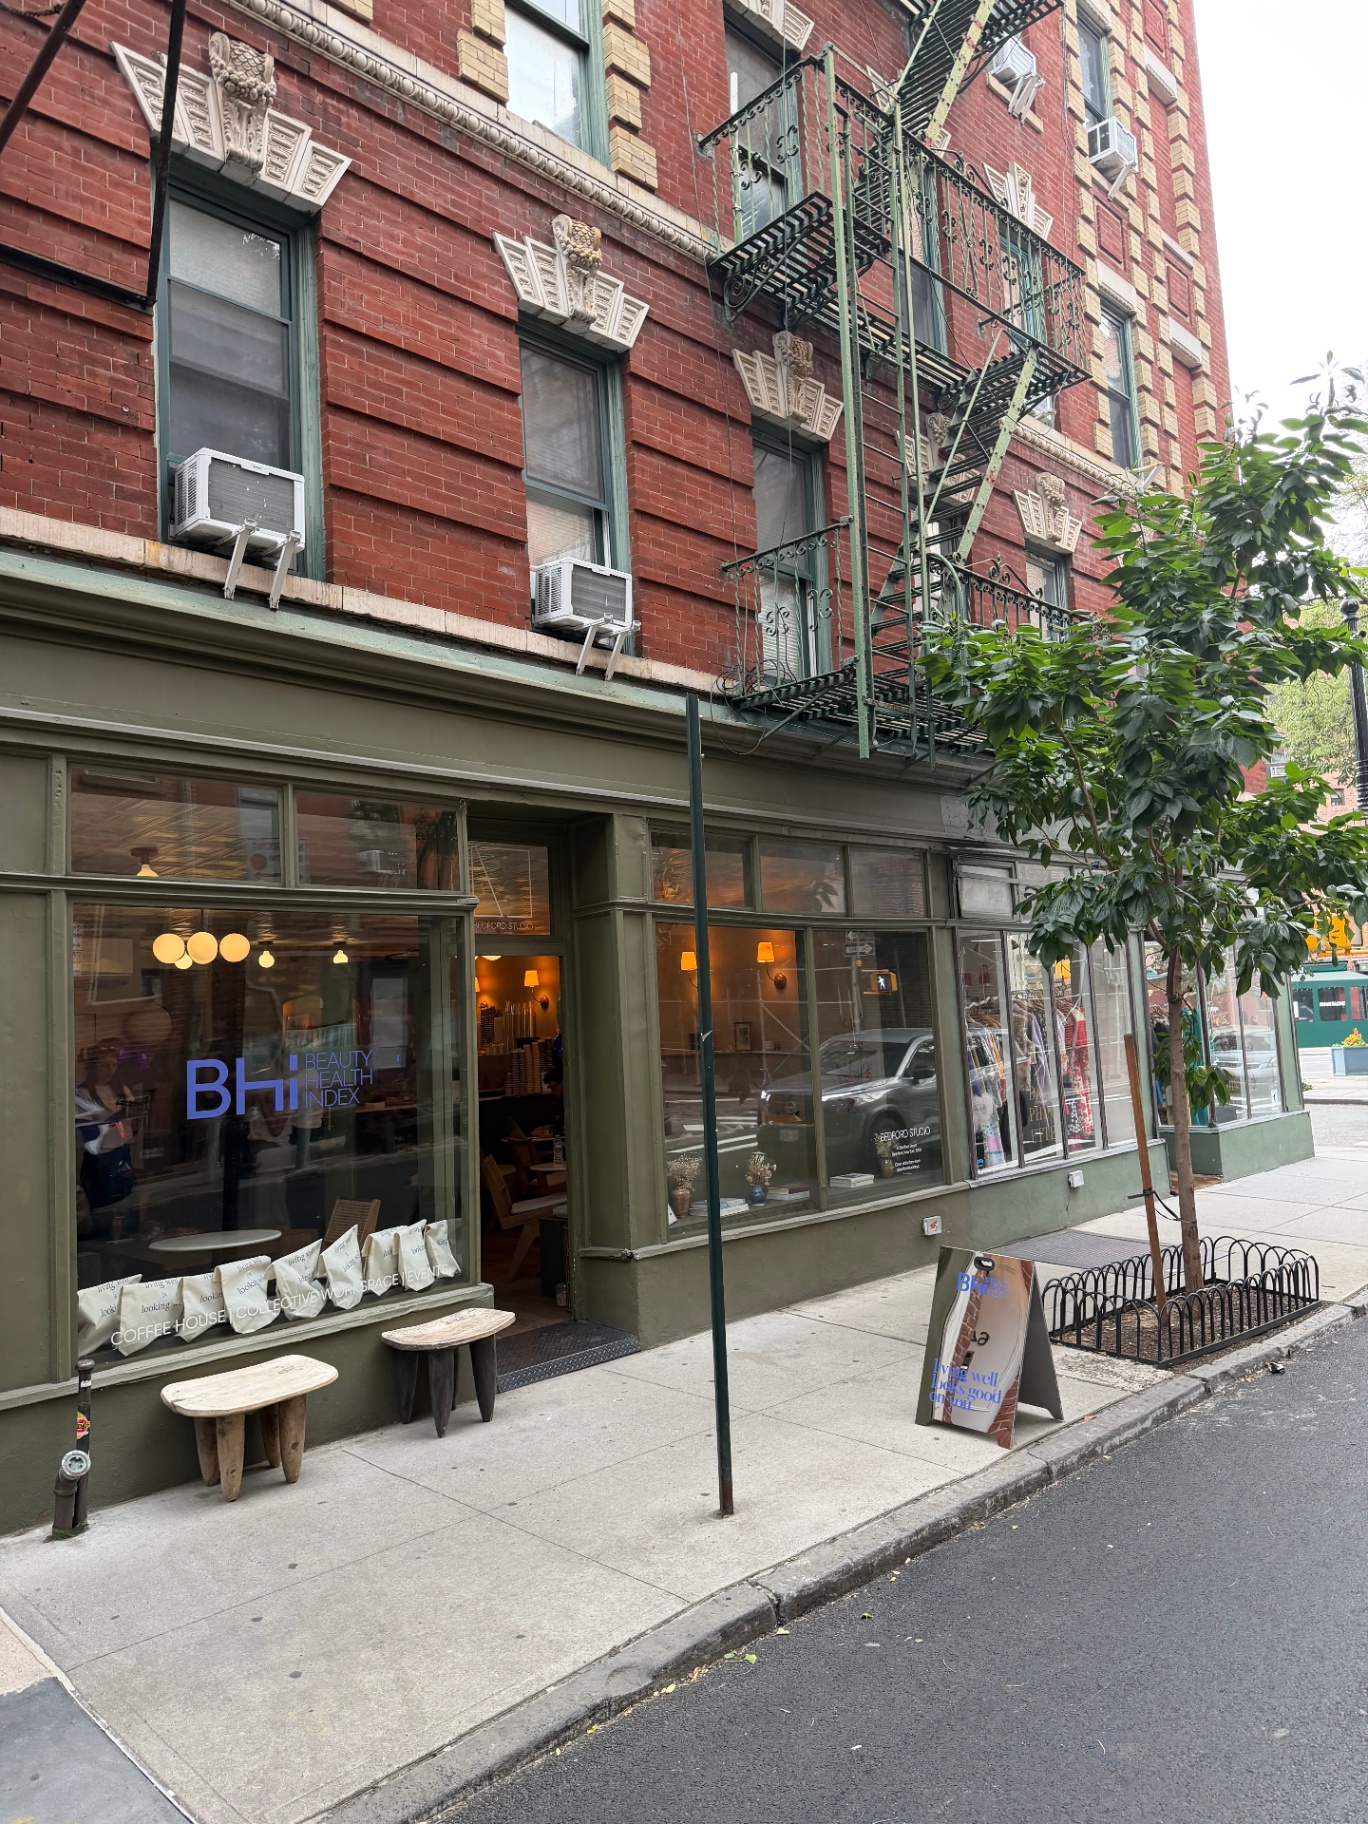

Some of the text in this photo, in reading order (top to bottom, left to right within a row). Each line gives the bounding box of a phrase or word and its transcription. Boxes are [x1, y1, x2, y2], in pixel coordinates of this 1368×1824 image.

[305, 1050, 373, 1072] BEAUTY
[305, 1068, 373, 1090] HEALTH
[305, 1087, 361, 1109] INDEX
[909, 1126, 931, 1138] STUDIO
[200, 1291, 223, 1304] lookin
[141, 1302, 170, 1314] looking
[111, 1320, 172, 1346] COFFEE
[175, 1309, 226, 1333] HOUSE
[971, 1371, 998, 1387] well
[967, 1387, 1002, 1404] good
